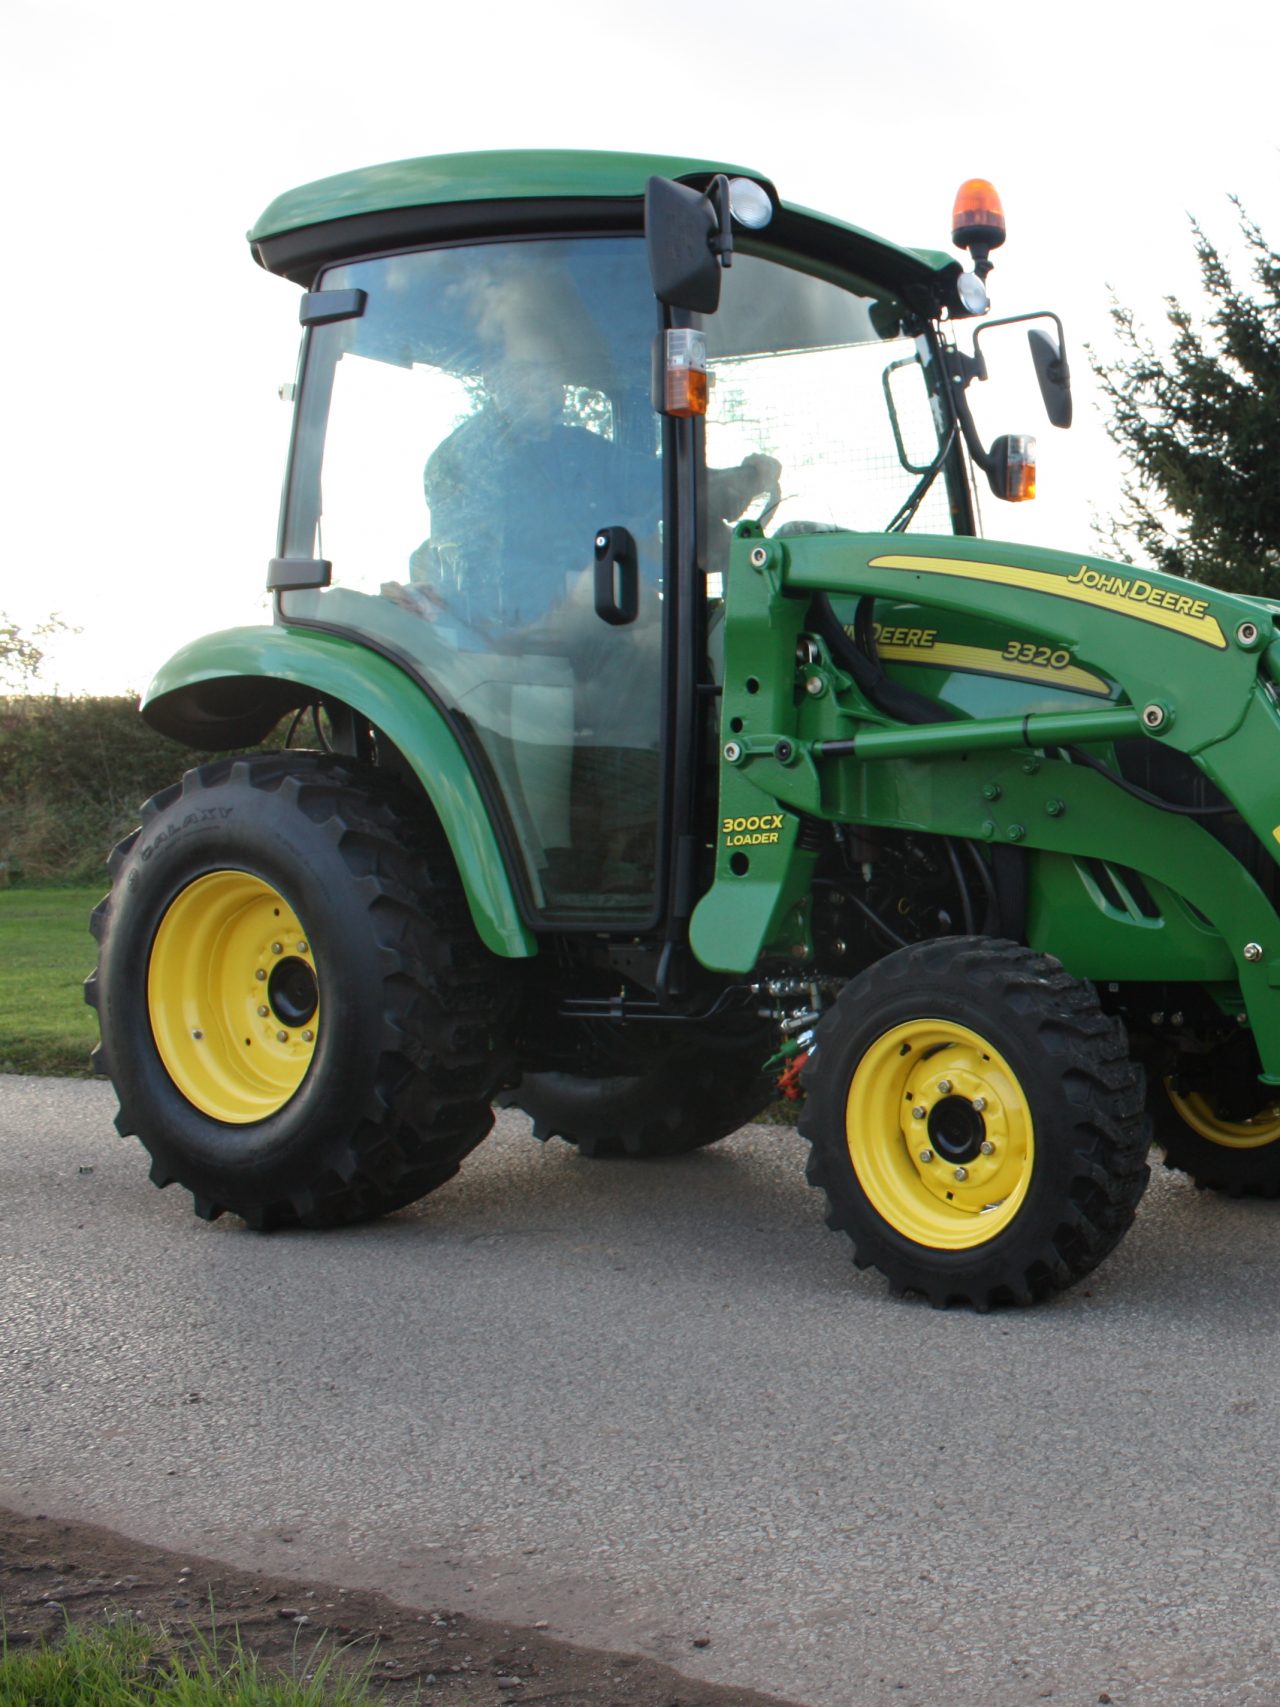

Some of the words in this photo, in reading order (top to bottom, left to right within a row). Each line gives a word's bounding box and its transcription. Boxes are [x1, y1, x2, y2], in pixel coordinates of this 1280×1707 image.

[1067, 564, 1130, 596] JOHN
[1127, 579, 1209, 617] DEERE
[1002, 640, 1071, 669] 3320
[722, 814, 784, 833] 300CX
[726, 832, 779, 846] LOADER
